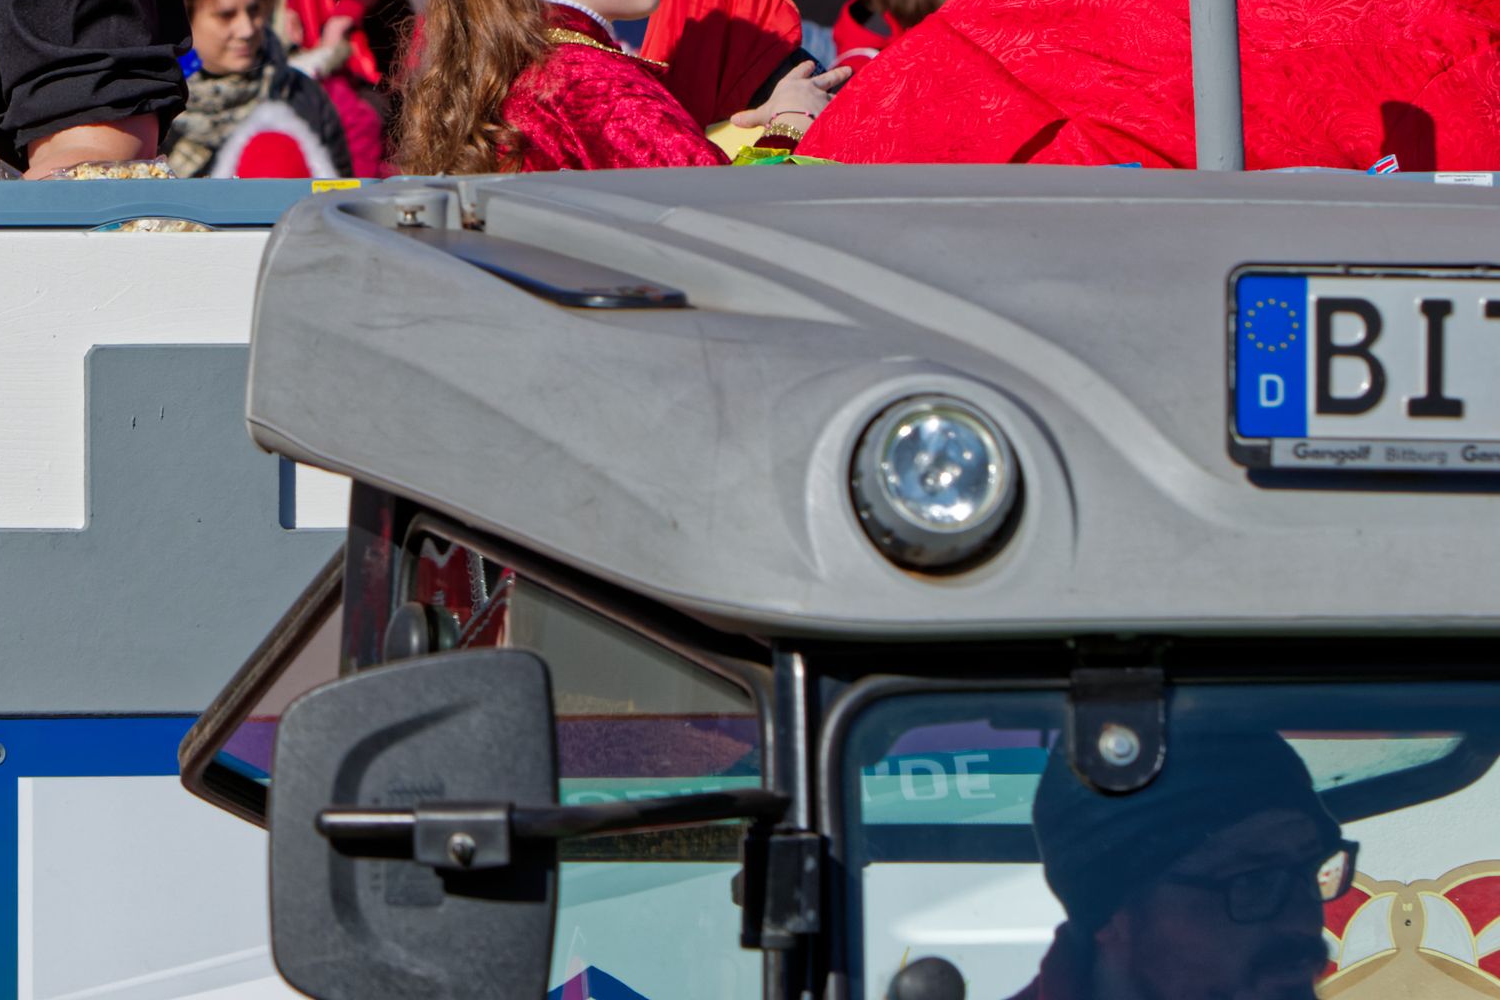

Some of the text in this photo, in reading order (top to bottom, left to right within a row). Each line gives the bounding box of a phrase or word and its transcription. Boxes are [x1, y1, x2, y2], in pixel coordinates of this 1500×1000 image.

[1259, 374, 1285, 407] D
[1293, 442, 1371, 465] Gangolf
[1384, 446, 1448, 465] Bitburg
